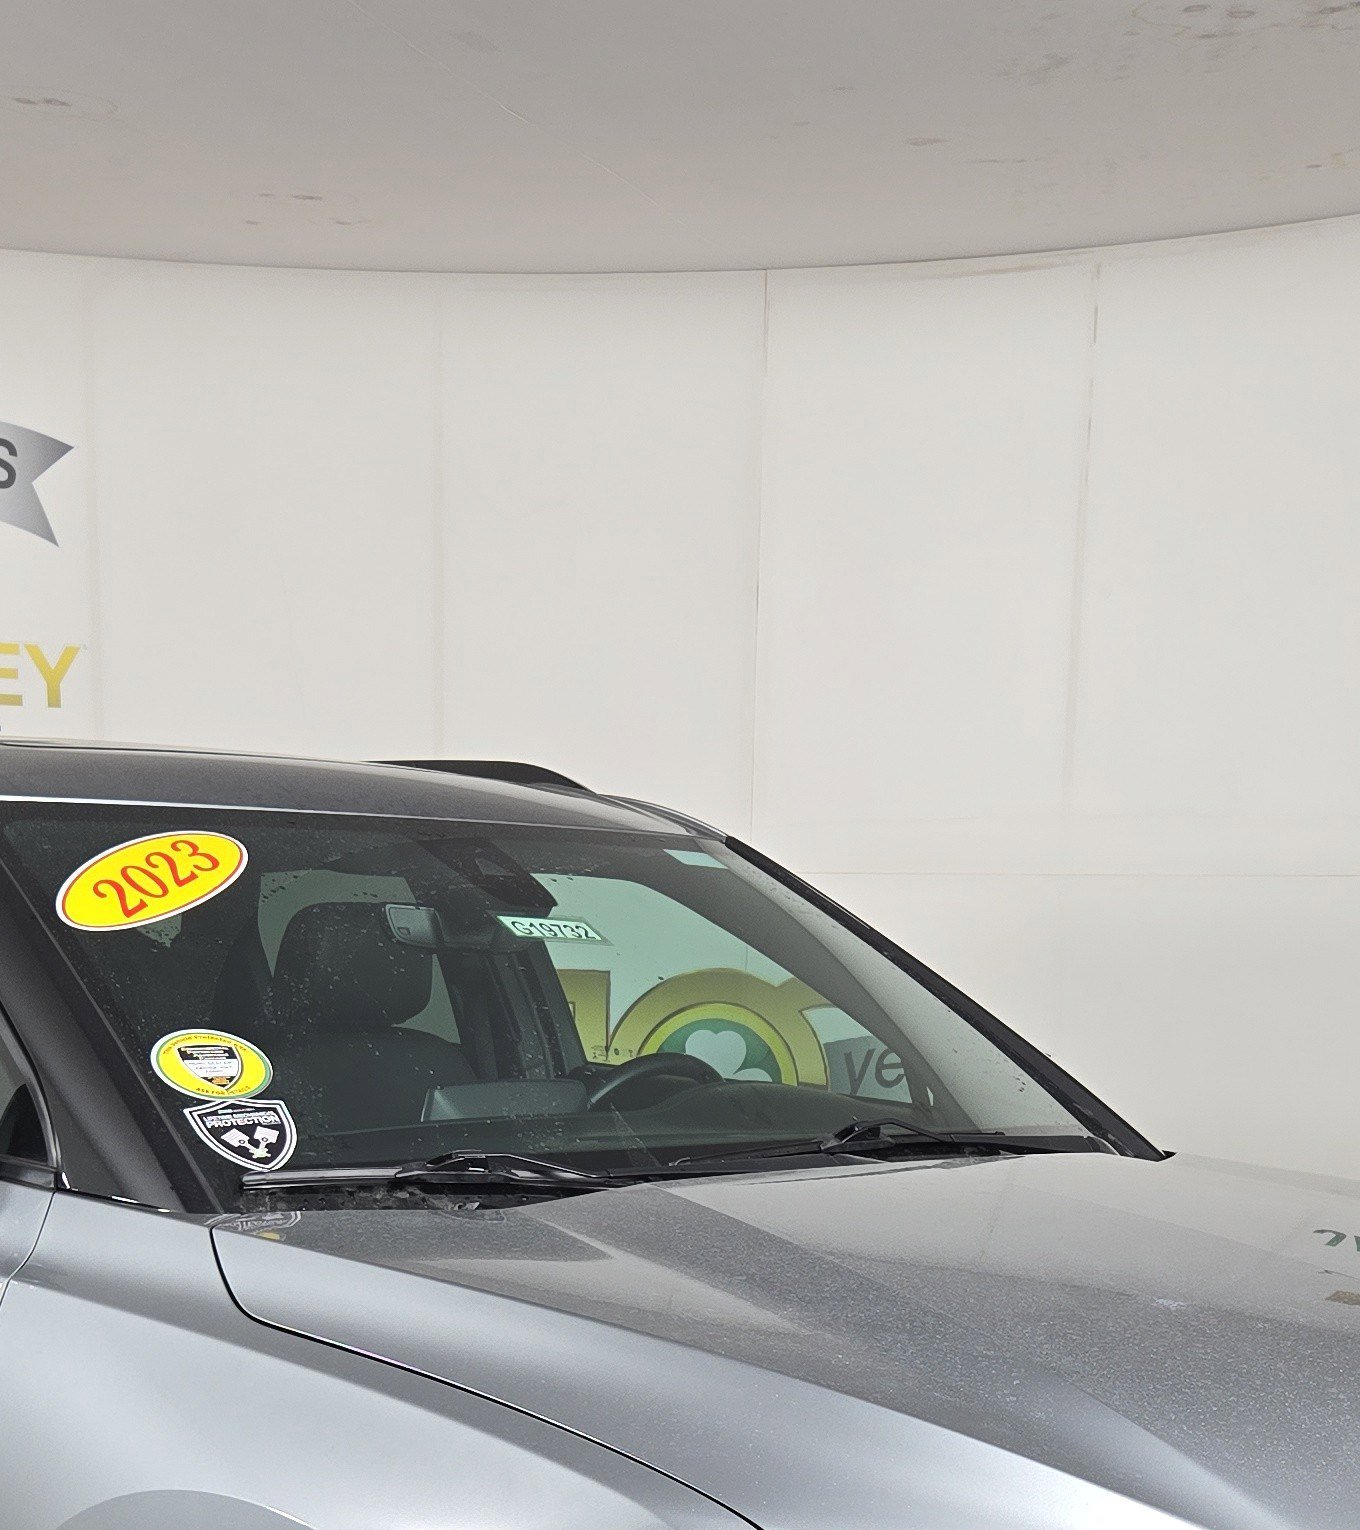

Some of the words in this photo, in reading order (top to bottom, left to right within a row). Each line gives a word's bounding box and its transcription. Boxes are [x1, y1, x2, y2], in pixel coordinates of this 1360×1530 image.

[93, 840, 220, 918] 2023
[511, 921, 597, 939] G19732
[205, 1114, 282, 1129] PROTECTION
